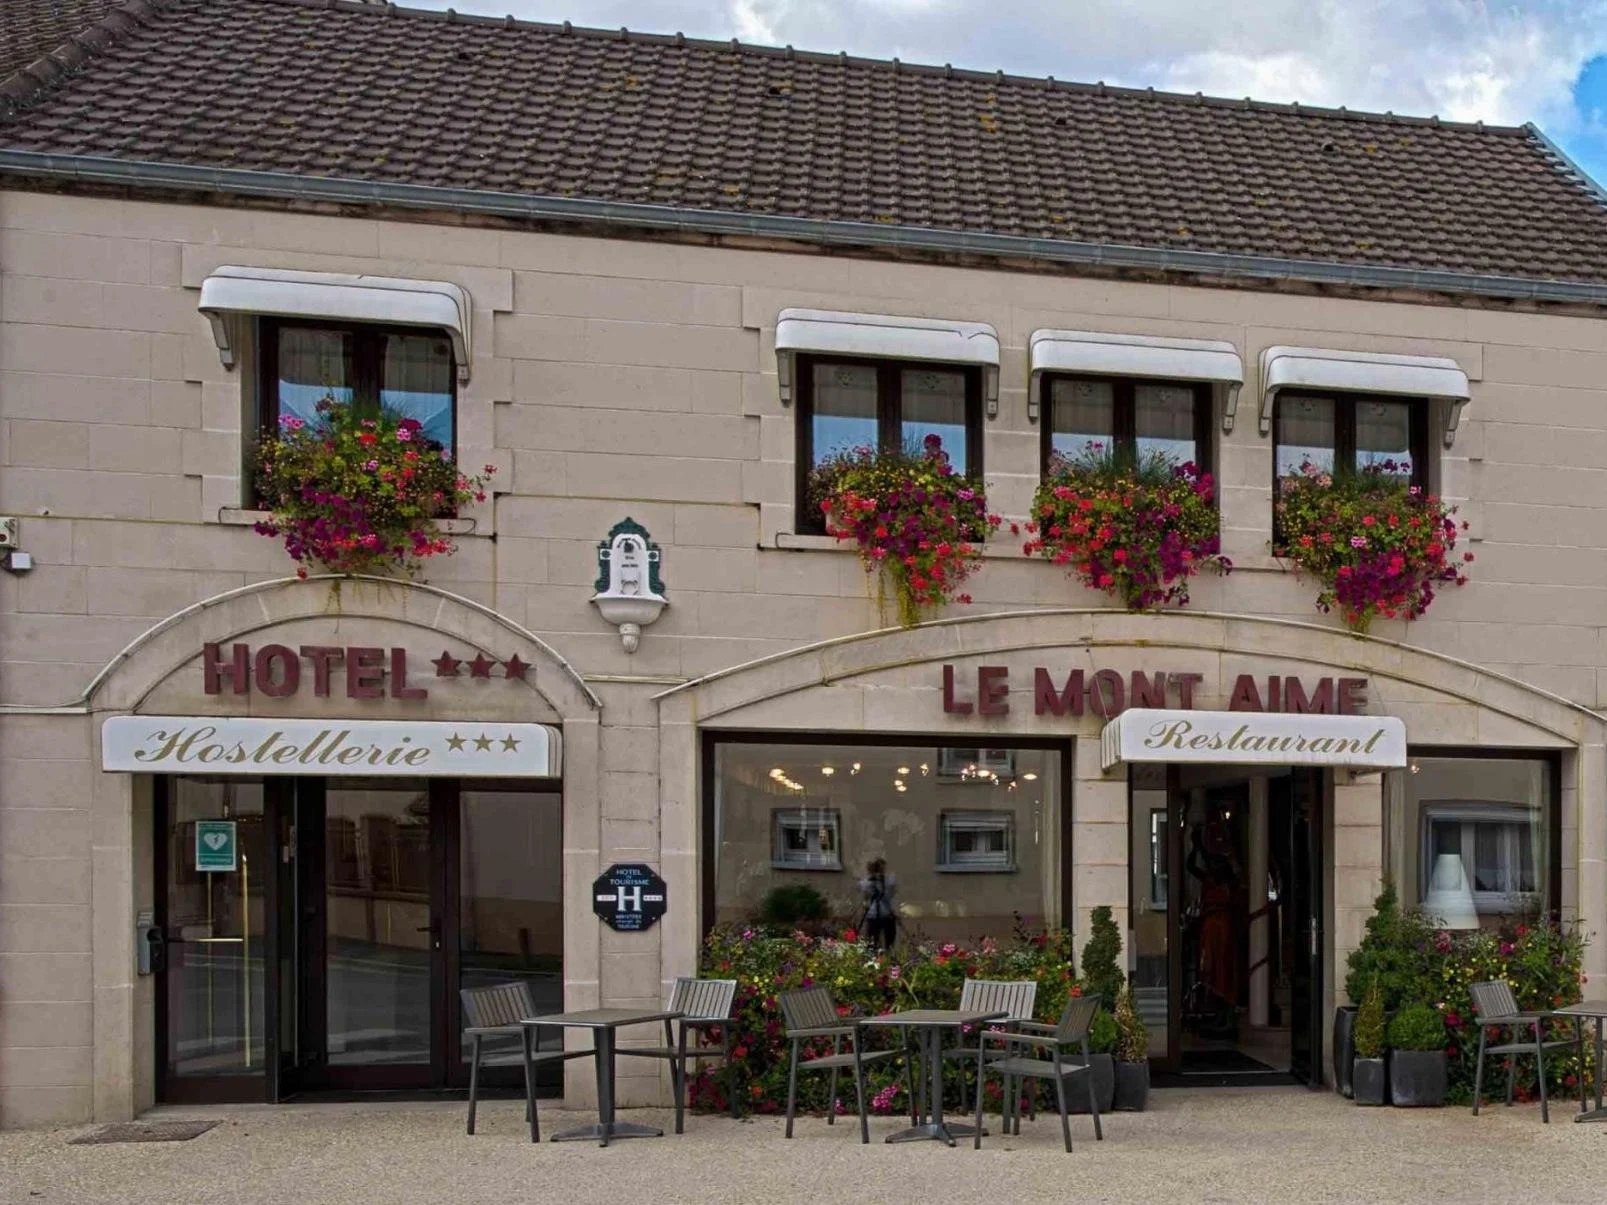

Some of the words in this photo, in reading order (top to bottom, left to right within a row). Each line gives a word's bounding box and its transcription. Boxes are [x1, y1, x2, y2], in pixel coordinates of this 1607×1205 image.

[203, 642, 428, 700] HOTEL
[942, 664, 1009, 716] LE
[1034, 667, 1203, 718] MONT
[1228, 674, 1369, 716] AIME
[134, 726, 432, 767] Hostellerie
[1143, 716, 1391, 755] Restaurant
[609, 878, 650, 886] TOURISME
[617, 886, 642, 912] H
